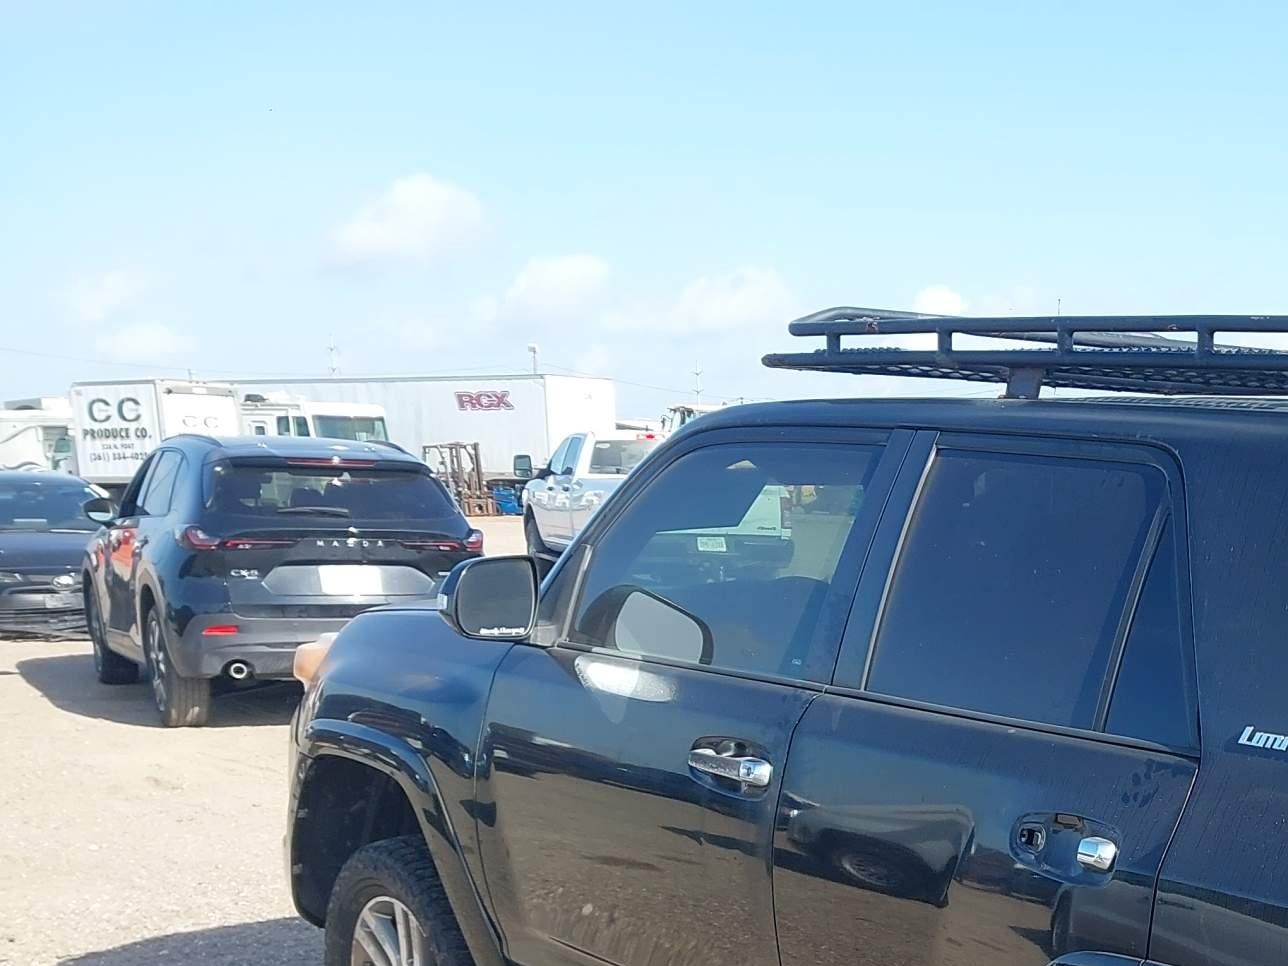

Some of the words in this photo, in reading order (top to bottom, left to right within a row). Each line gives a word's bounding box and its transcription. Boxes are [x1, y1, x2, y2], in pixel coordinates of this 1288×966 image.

[82, 427, 130, 440] PRODUCE
[135, 427, 152, 439] CO.
[316, 539, 384, 548] MAZDA
